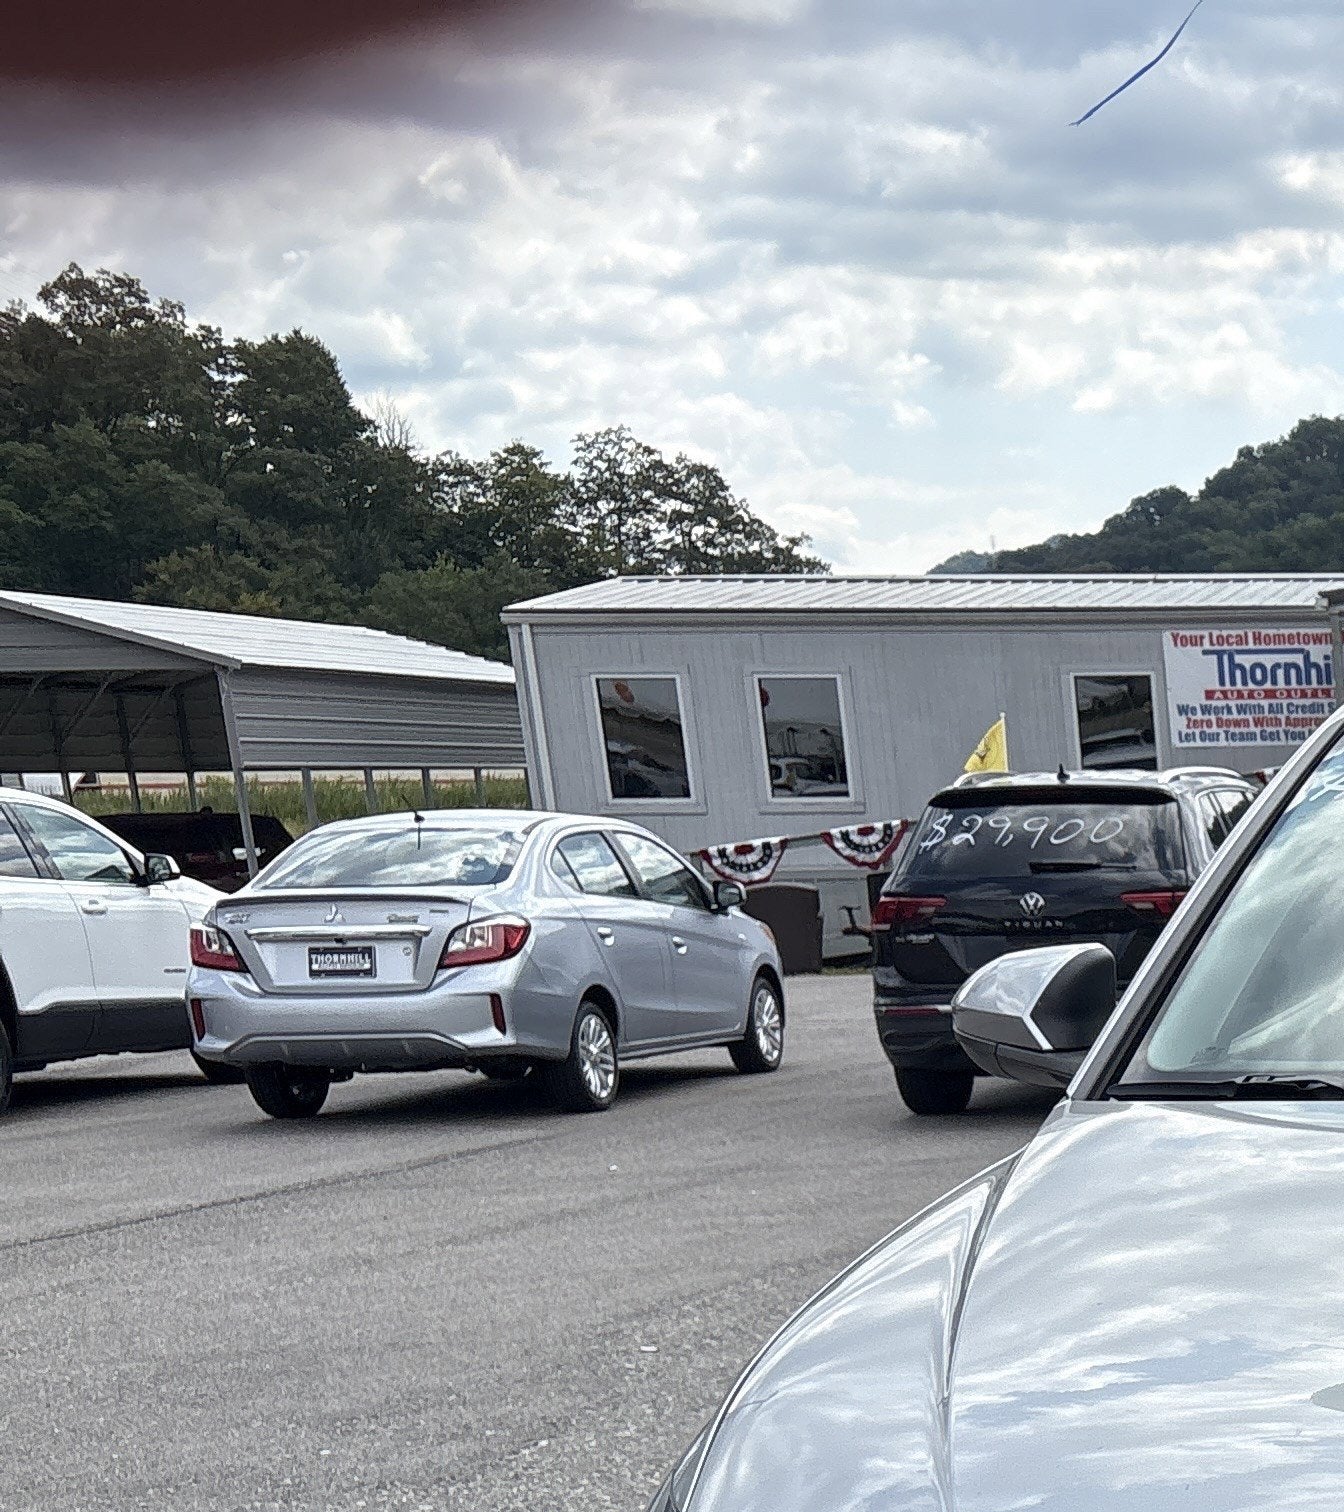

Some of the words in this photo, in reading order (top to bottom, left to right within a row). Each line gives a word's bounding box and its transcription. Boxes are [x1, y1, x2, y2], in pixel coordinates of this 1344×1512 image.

[1171, 631, 1204, 648] Your
[1209, 631, 1248, 647] Local
[1252, 630, 1334, 647] Hometown
[1214, 689, 1265, 700] AUTO
[1276, 688, 1338, 699] OUTL
[1177, 704, 1197, 717] We
[1200, 704, 1233, 717] Work
[1236, 703, 1265, 716] With
[1267, 702, 1284, 716] All
[1286, 702, 1325, 715] Credit
[1185, 717, 1213, 730] Zero
[1216, 717, 1250, 729] Down
[1252, 716, 1283, 729] With
[1178, 731, 1197, 744] Let
[1200, 730, 1221, 743] Our
[1223, 730, 1258, 743] Team
[1260, 729, 1281, 742] Get
[1284, 729, 1307, 742] You
[918, 812, 1124, 854] $29,900
